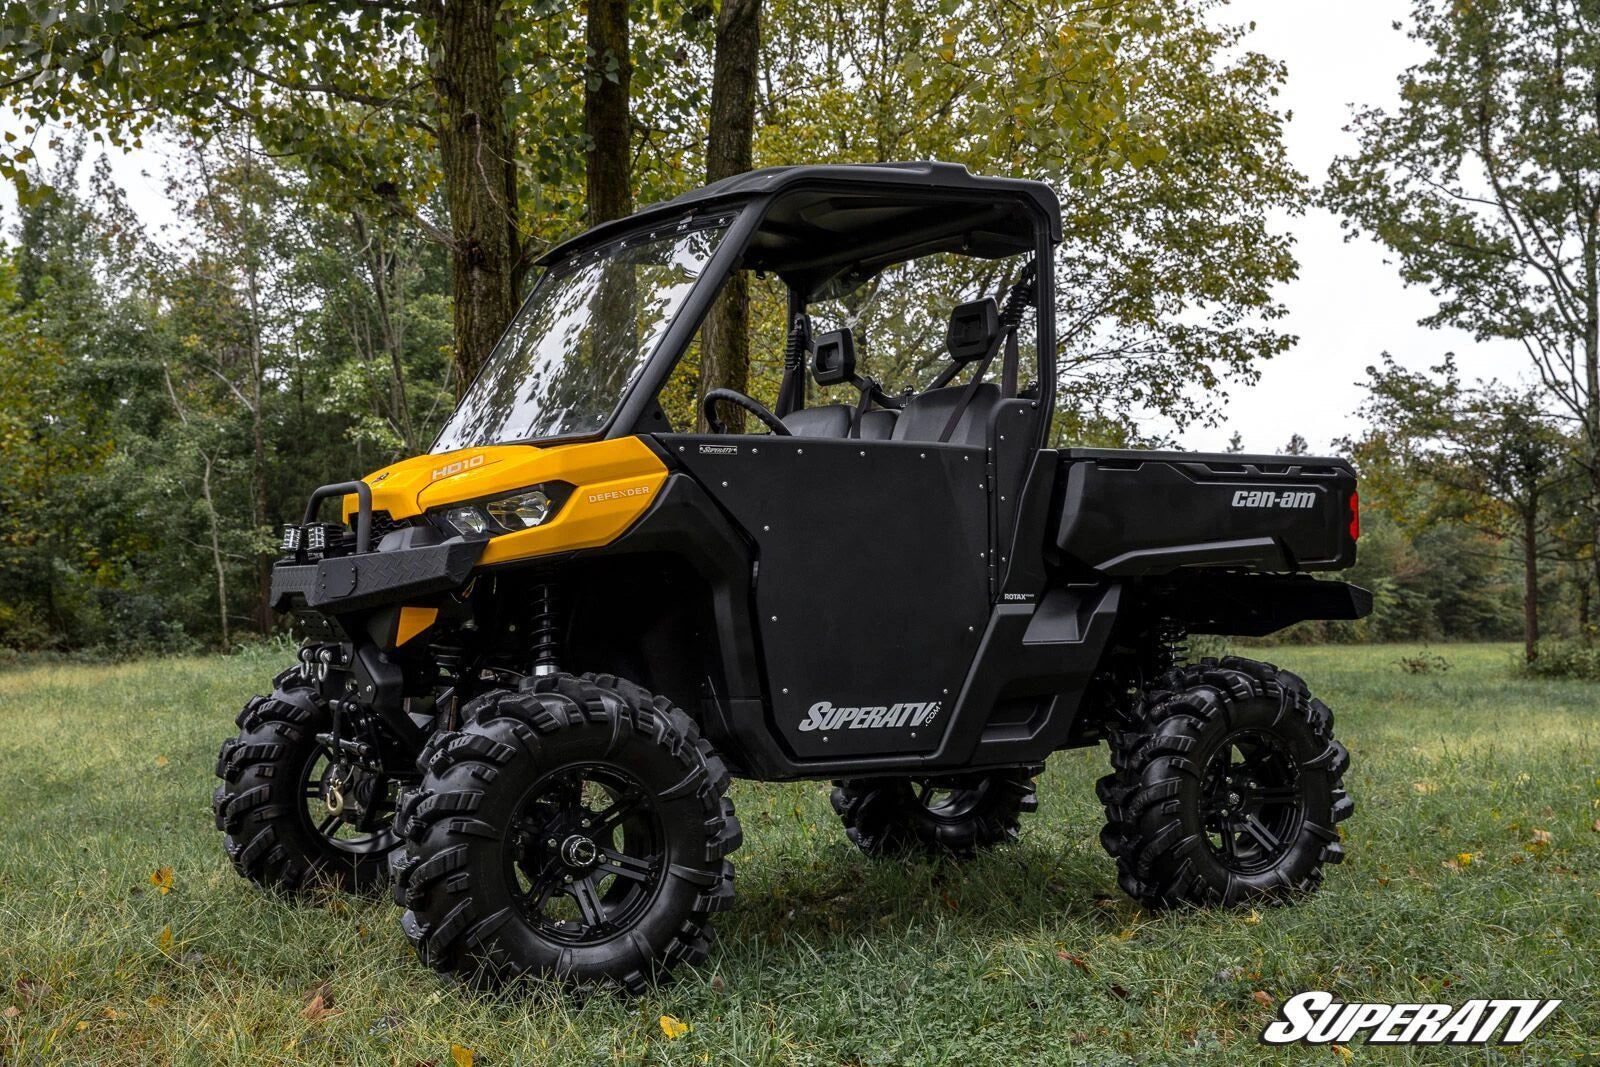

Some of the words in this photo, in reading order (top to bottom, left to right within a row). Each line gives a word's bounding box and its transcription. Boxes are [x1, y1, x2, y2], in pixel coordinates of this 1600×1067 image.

[432, 455, 484, 480] HD10
[588, 486, 650, 503] DEFENDER
[1231, 490, 1316, 508] can-am
[798, 701, 937, 732] SUPERATV
